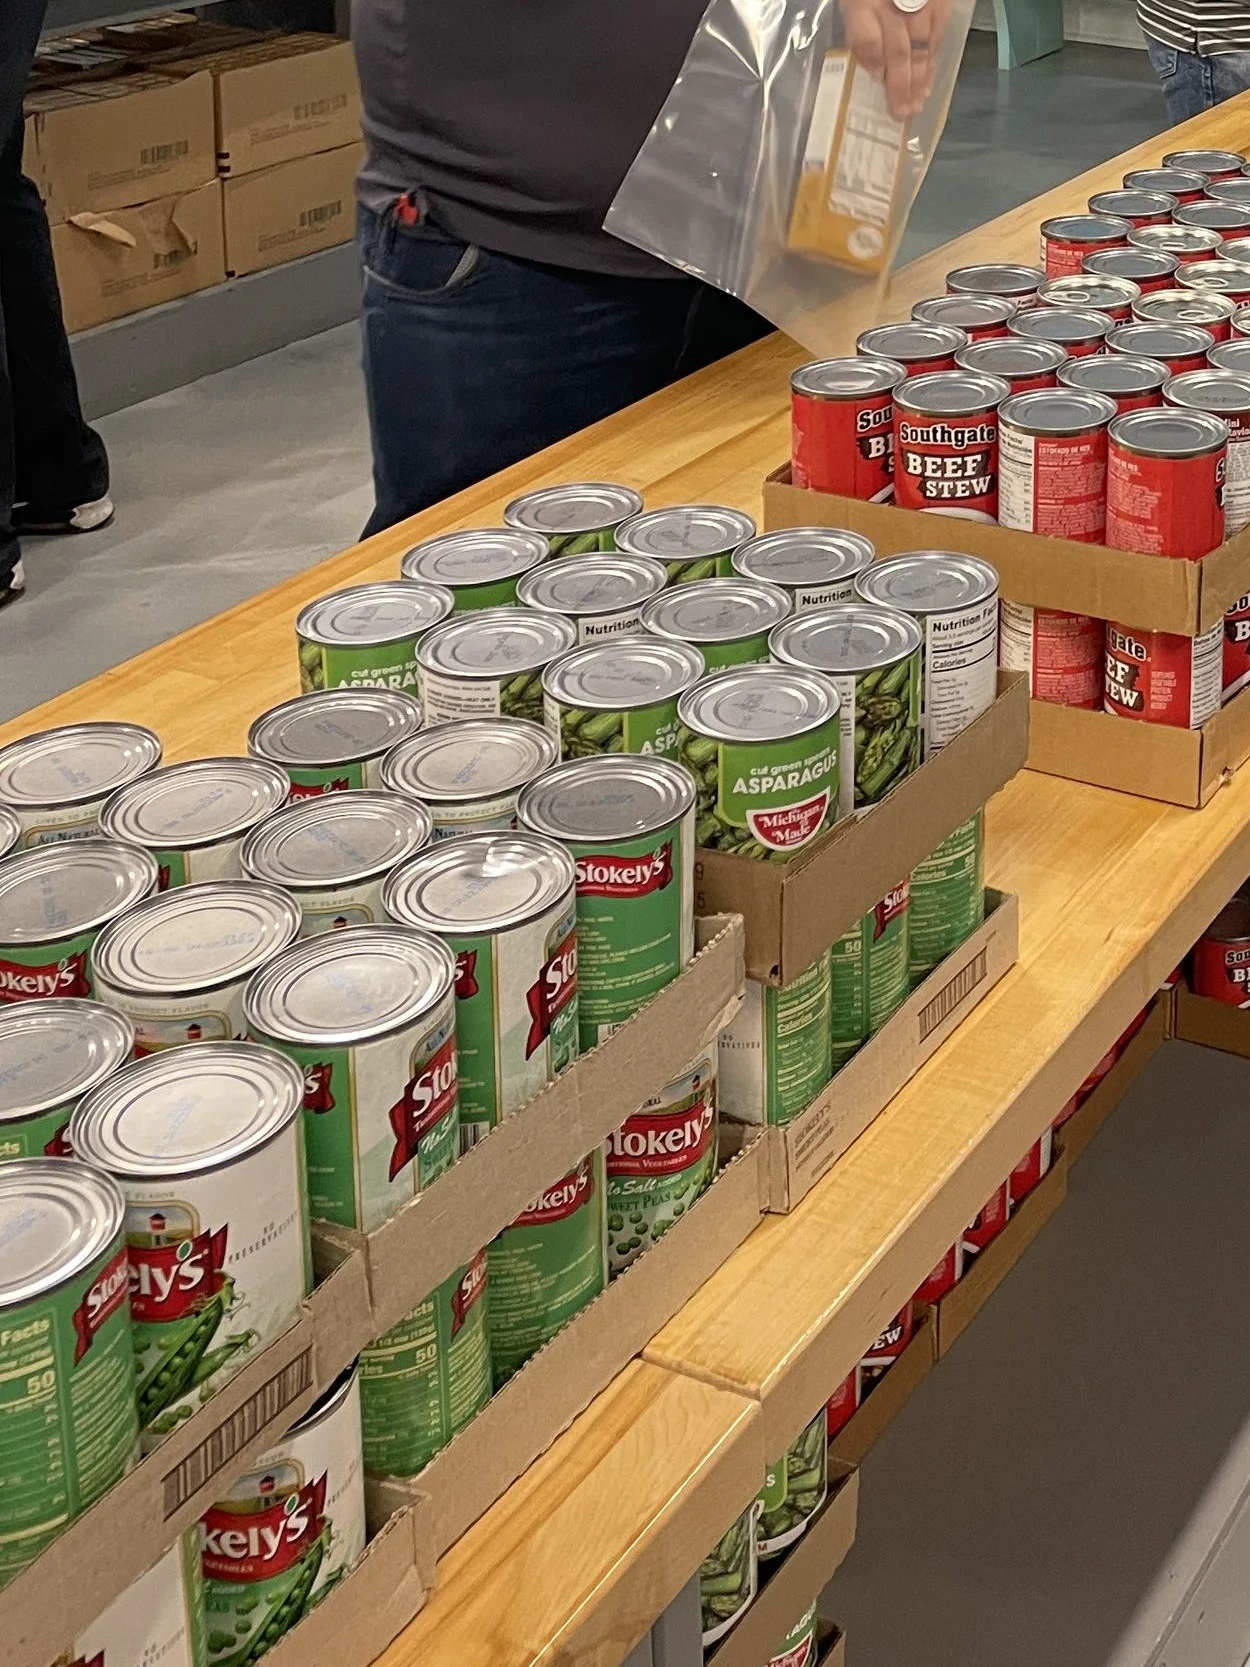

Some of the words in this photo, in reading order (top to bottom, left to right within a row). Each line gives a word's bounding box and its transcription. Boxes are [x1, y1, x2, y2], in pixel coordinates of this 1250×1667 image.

[899, 423, 996, 447] Southgate
[906, 453, 983, 477] BEEF
[925, 477, 991, 498] STEW
[802, 589, 852, 605] Nutrition
[585, 618, 639, 637] Nutrition
[933, 614, 980, 632] Nutrition
[351, 668, 368, 679] cut
[371, 664, 401, 679] green
[933, 658, 966, 669] Calories
[1106, 653, 1129, 684] EF
[733, 750, 836, 794] ASPARAGUS
[750, 766, 769, 775] cut
[771, 761, 802, 775] green
[758, 805, 820, 828] Michigan
[772, 822, 811, 842] Made
[574, 849, 664, 884] Stokely's
[643, 1192, 672, 1209] PEAS
[415, 1344, 437, 1364] 50
[27, 1370, 56, 1394] 50
[201, 1508, 309, 1561] kely's
